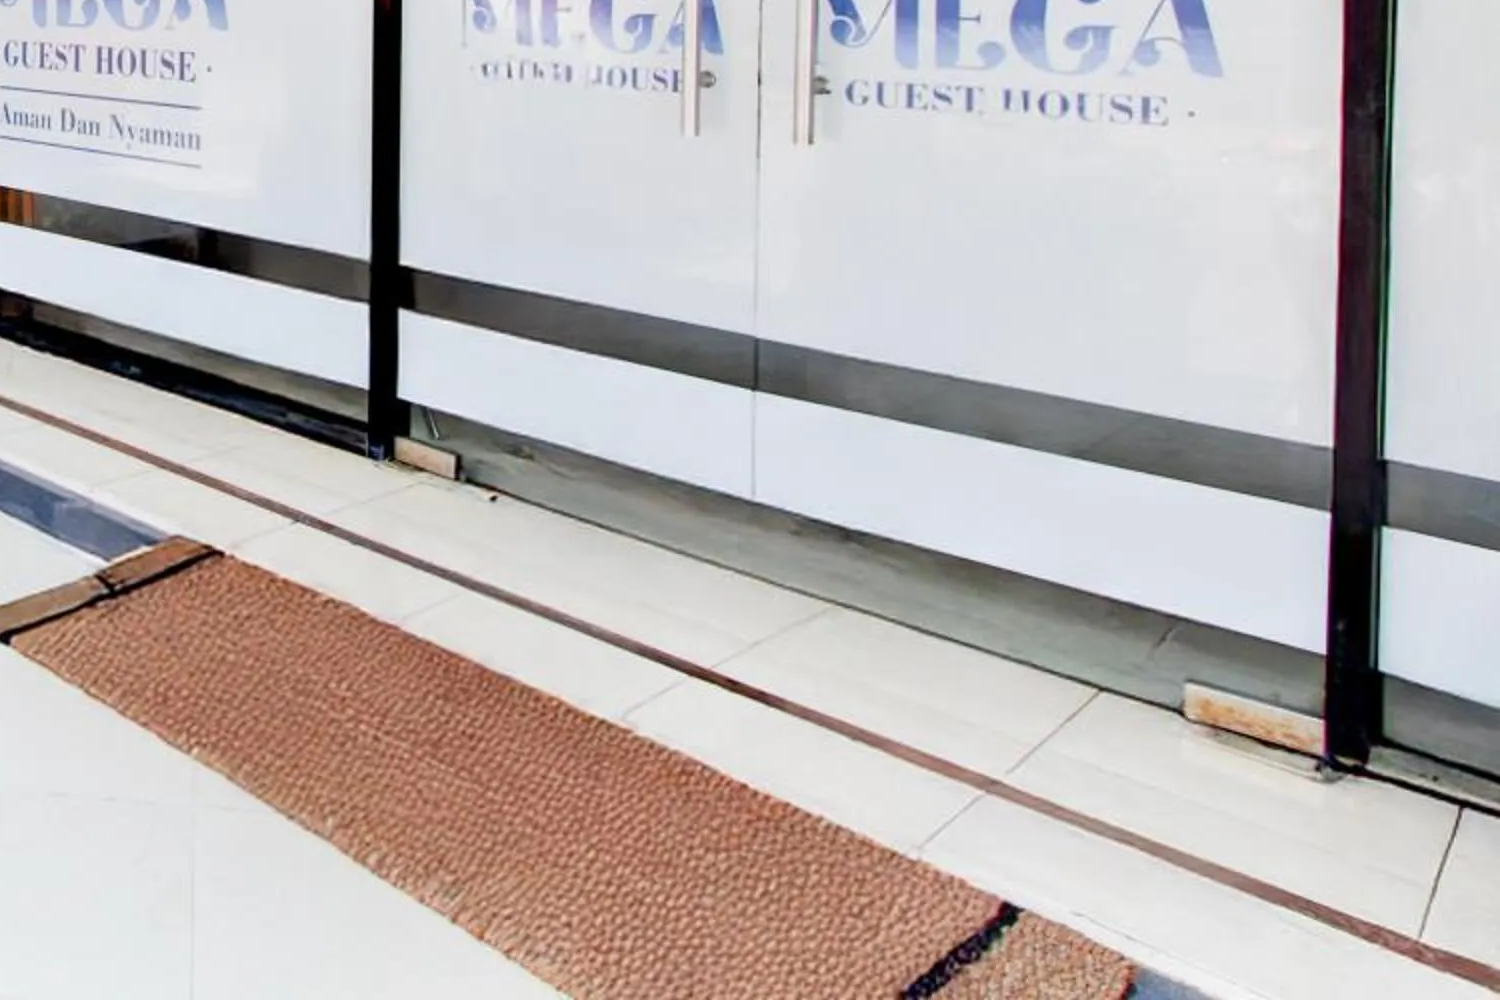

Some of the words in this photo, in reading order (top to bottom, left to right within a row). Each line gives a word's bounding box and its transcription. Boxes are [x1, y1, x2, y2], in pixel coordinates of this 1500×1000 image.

[3, 39, 86, 74] GUEST
[95, 45, 197, 83] HOUSE
[845, 78, 985, 116] GUEST
[1003, 88, 1170, 127] HOUSE
[0, 104, 52, 131] Aman
[60, 108, 100, 137] Dan
[108, 114, 201, 150] Nyaman
